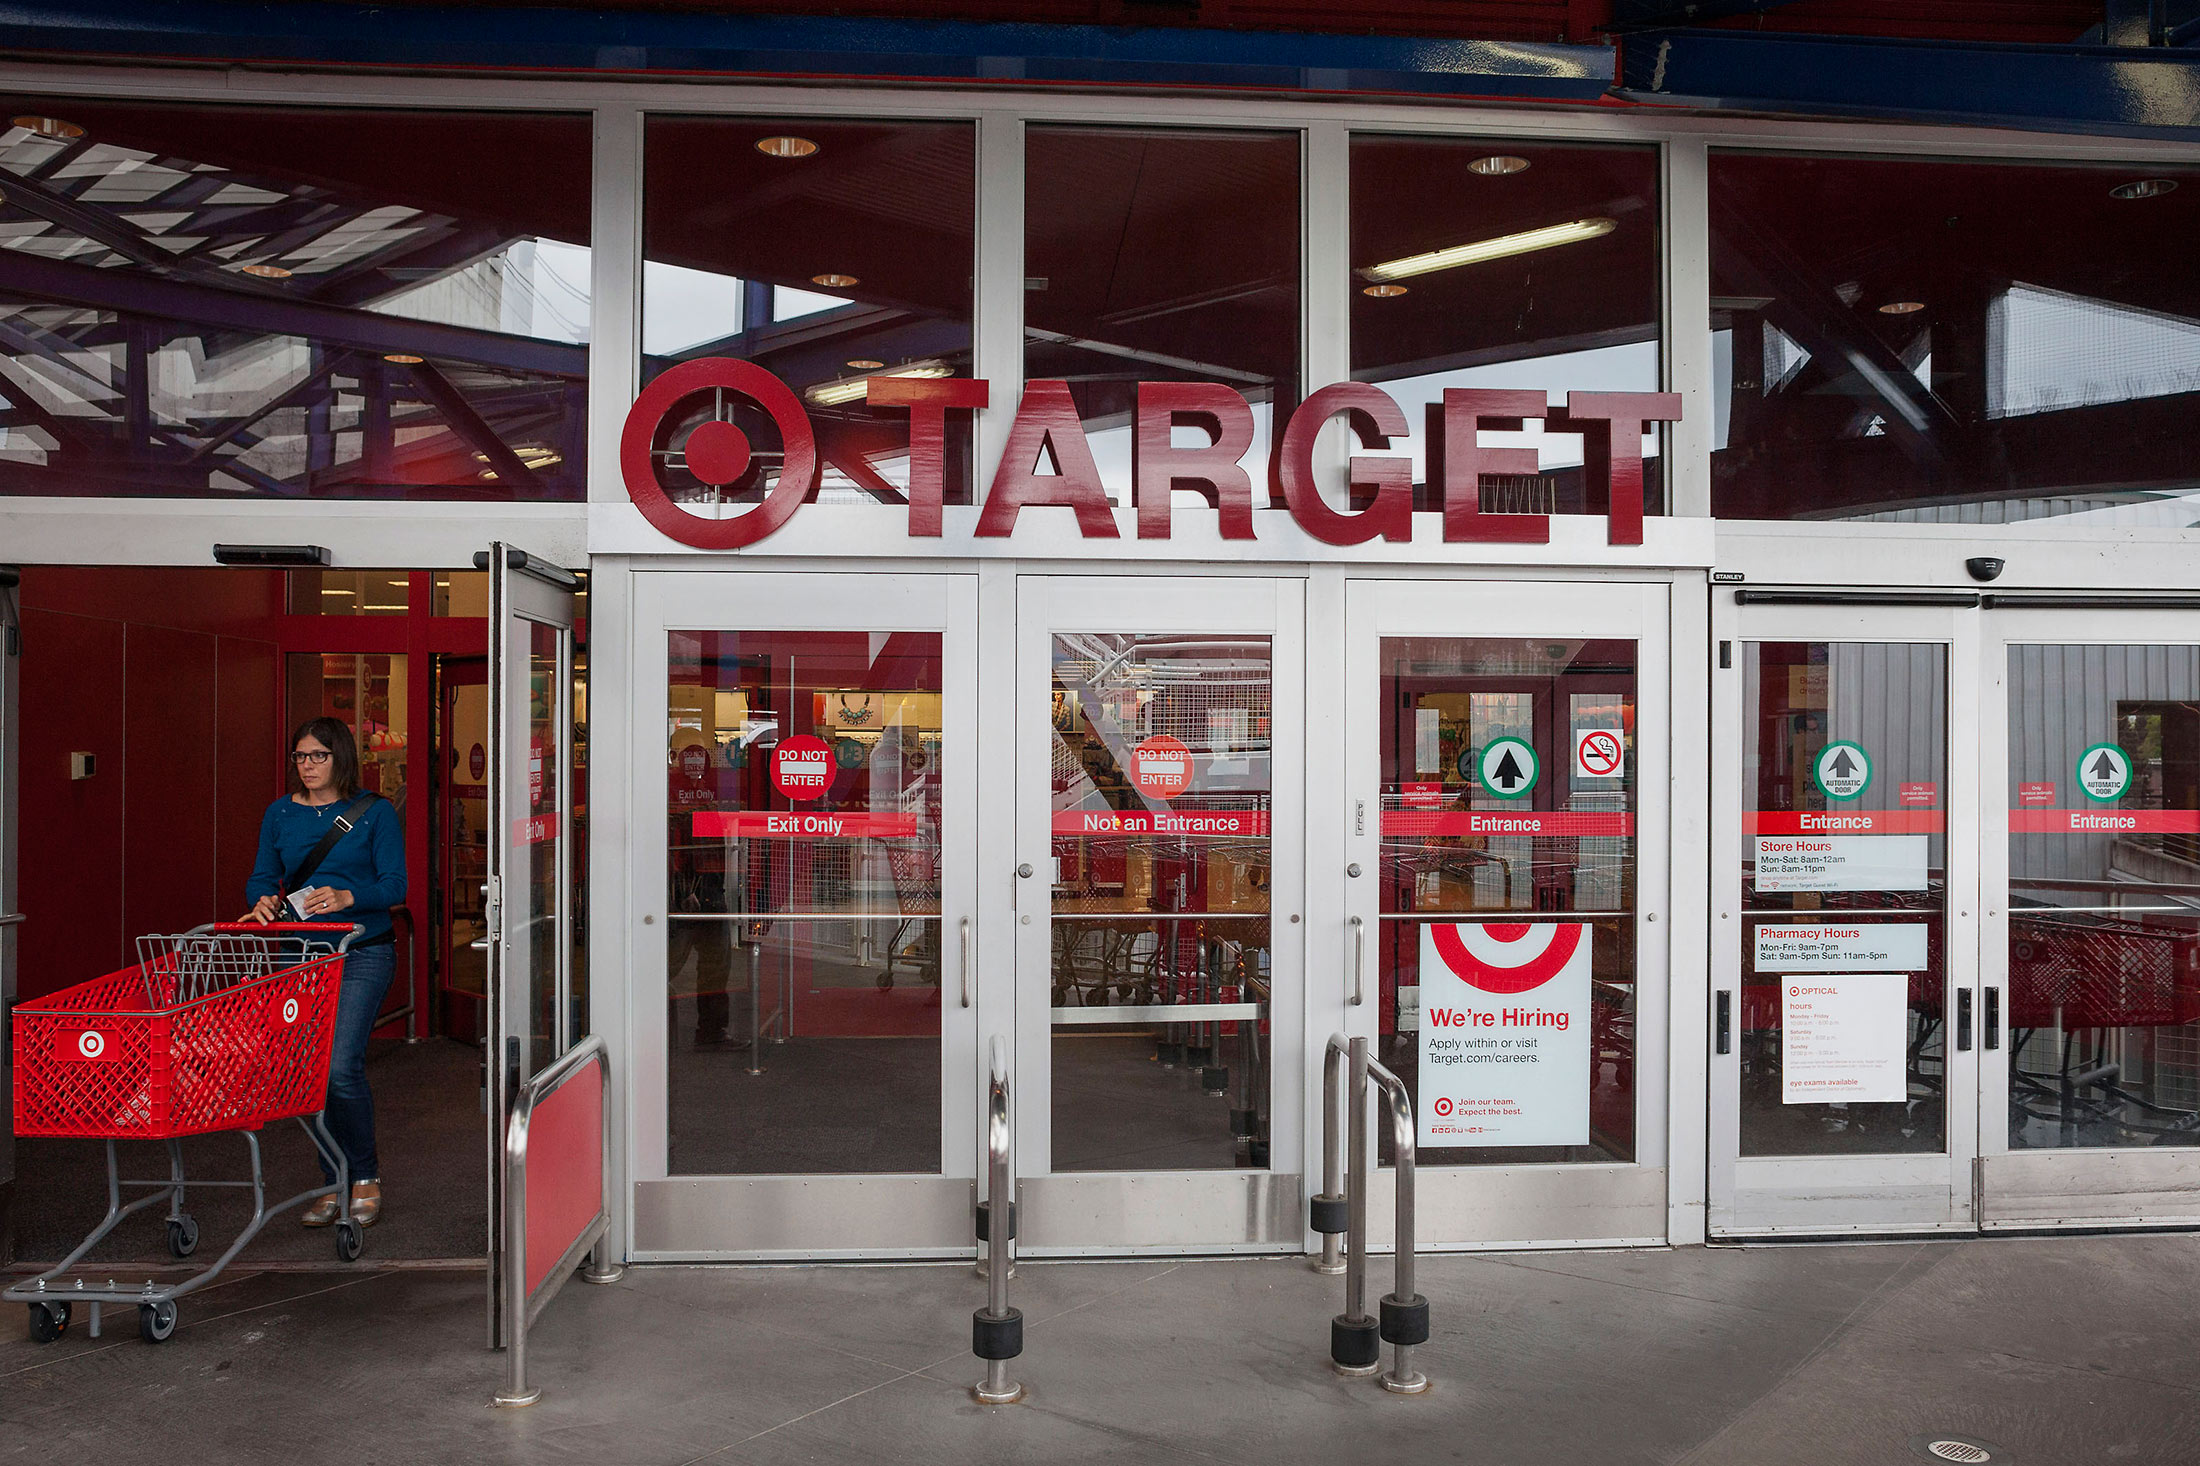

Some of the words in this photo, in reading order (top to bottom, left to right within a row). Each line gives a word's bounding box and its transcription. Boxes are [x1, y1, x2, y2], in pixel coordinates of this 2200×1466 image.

[866, 377, 1682, 546] TARGET
[779, 750, 799, 762] DO
[801, 750, 828, 762] NOT
[1138, 750, 1157, 761] DO
[1160, 750, 1186, 761] NOT
[781, 775, 824, 787] ENTER
[1140, 774, 1183, 786] ENTER
[679, 789, 694, 799] Exit
[696, 789, 715, 801] Only
[767, 816, 800, 833] Exit
[804, 815, 843, 837] Only
[1084, 814, 1120, 832] Not
[1123, 818, 1147, 832] an
[1154, 814, 1240, 832] Entrance
[1470, 815, 1542, 832] Entrance
[1800, 814, 1873, 829] Entrance
[2070, 814, 2136, 829] Entrance
[1761, 841, 1793, 852] Store
[1796, 841, 1832, 852] Hours
[1761, 856, 1799, 864] Mon-Sat:
[1800, 856, 1846, 864] 8am-12am
[1761, 865, 1780, 873] Sun:
[1781, 865, 1826, 874] 8am-11pm
[1760, 928, 1821, 941] Pharmacy
[1824, 928, 1860, 938] Hours
[1760, 943, 1797, 951] Mon-Fri:
[1798, 943, 1839, 952] 9am-7pm
[1760, 952, 1777, 960] Sat:
[1779, 952, 1820, 961] 9am-5pm
[1821, 952, 1841, 960] Sun:
[1843, 952, 1888, 961] 11am-5pm
[1801, 987, 1838, 995] OPTICAL
[1502, 1008, 1570, 1031] Hiring
[1429, 1038, 1461, 1051] Apply
[1464, 1038, 1498, 1048] within
[1501, 1040, 1513, 1048] or
[1515, 1037, 1538, 1048] visit
[1429, 1052, 1540, 1066] Target.com/careers.
[1789, 1080, 1802, 1088] eye
[1828, 1078, 1859, 1086] available
[1458, 1098, 1476, 1106] Join
[1458, 1108, 1486, 1116] Expect
